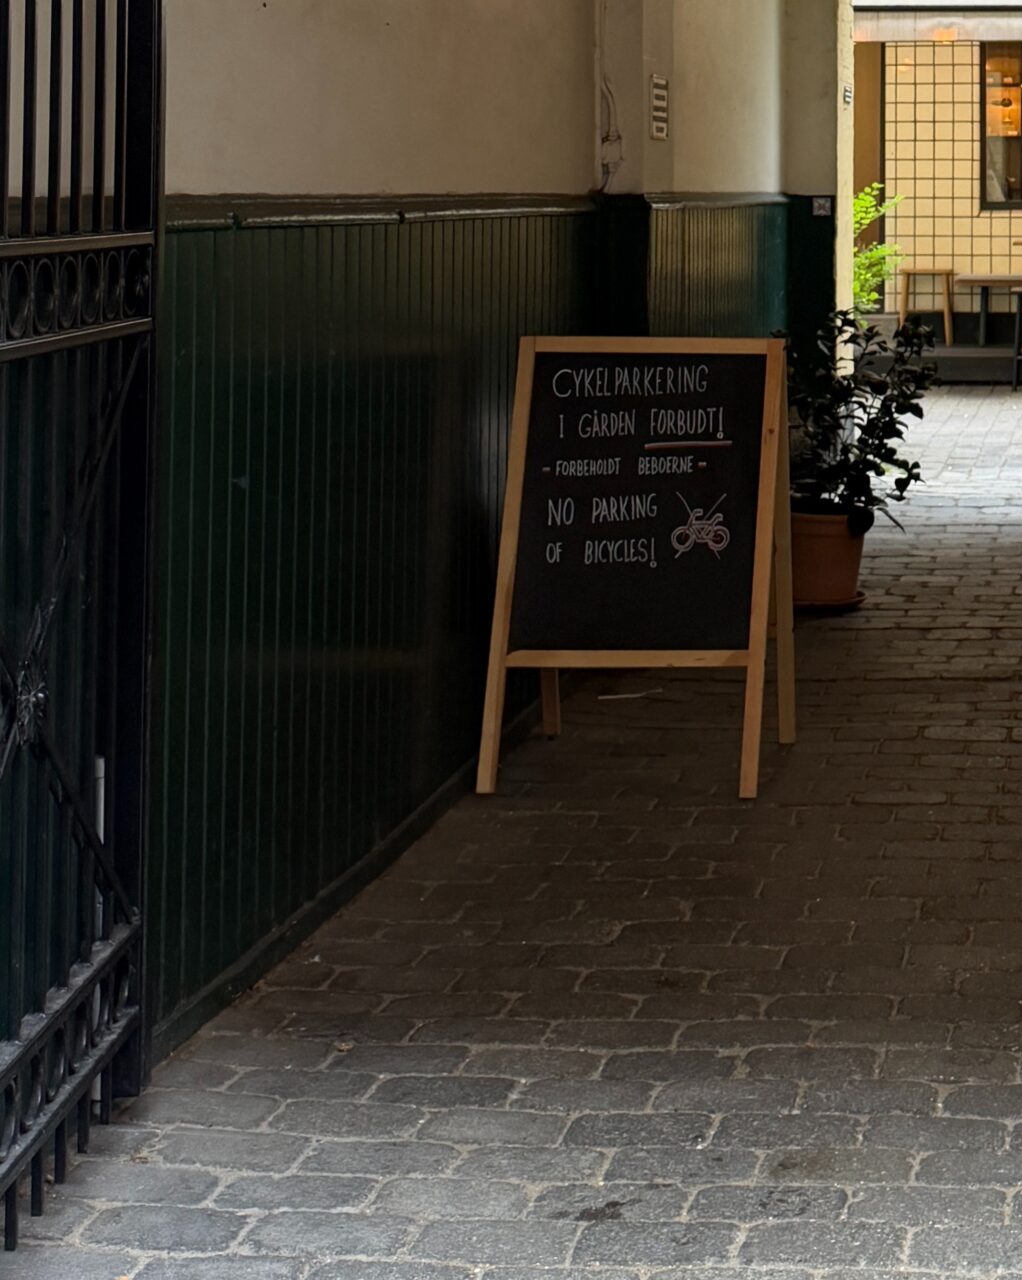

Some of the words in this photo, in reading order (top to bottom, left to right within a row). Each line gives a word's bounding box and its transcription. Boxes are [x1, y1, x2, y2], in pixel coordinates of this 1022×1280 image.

[552, 365, 709, 397] CYKELPARKERING
[578, 409, 636, 438] GÅRDEN
[650, 406, 724, 439] FORBUDT!
[548, 497, 575, 526] NO
[591, 493, 658, 524] PARKING
[545, 542, 563, 564] OF
[584, 537, 657, 568] BICYCLES!
